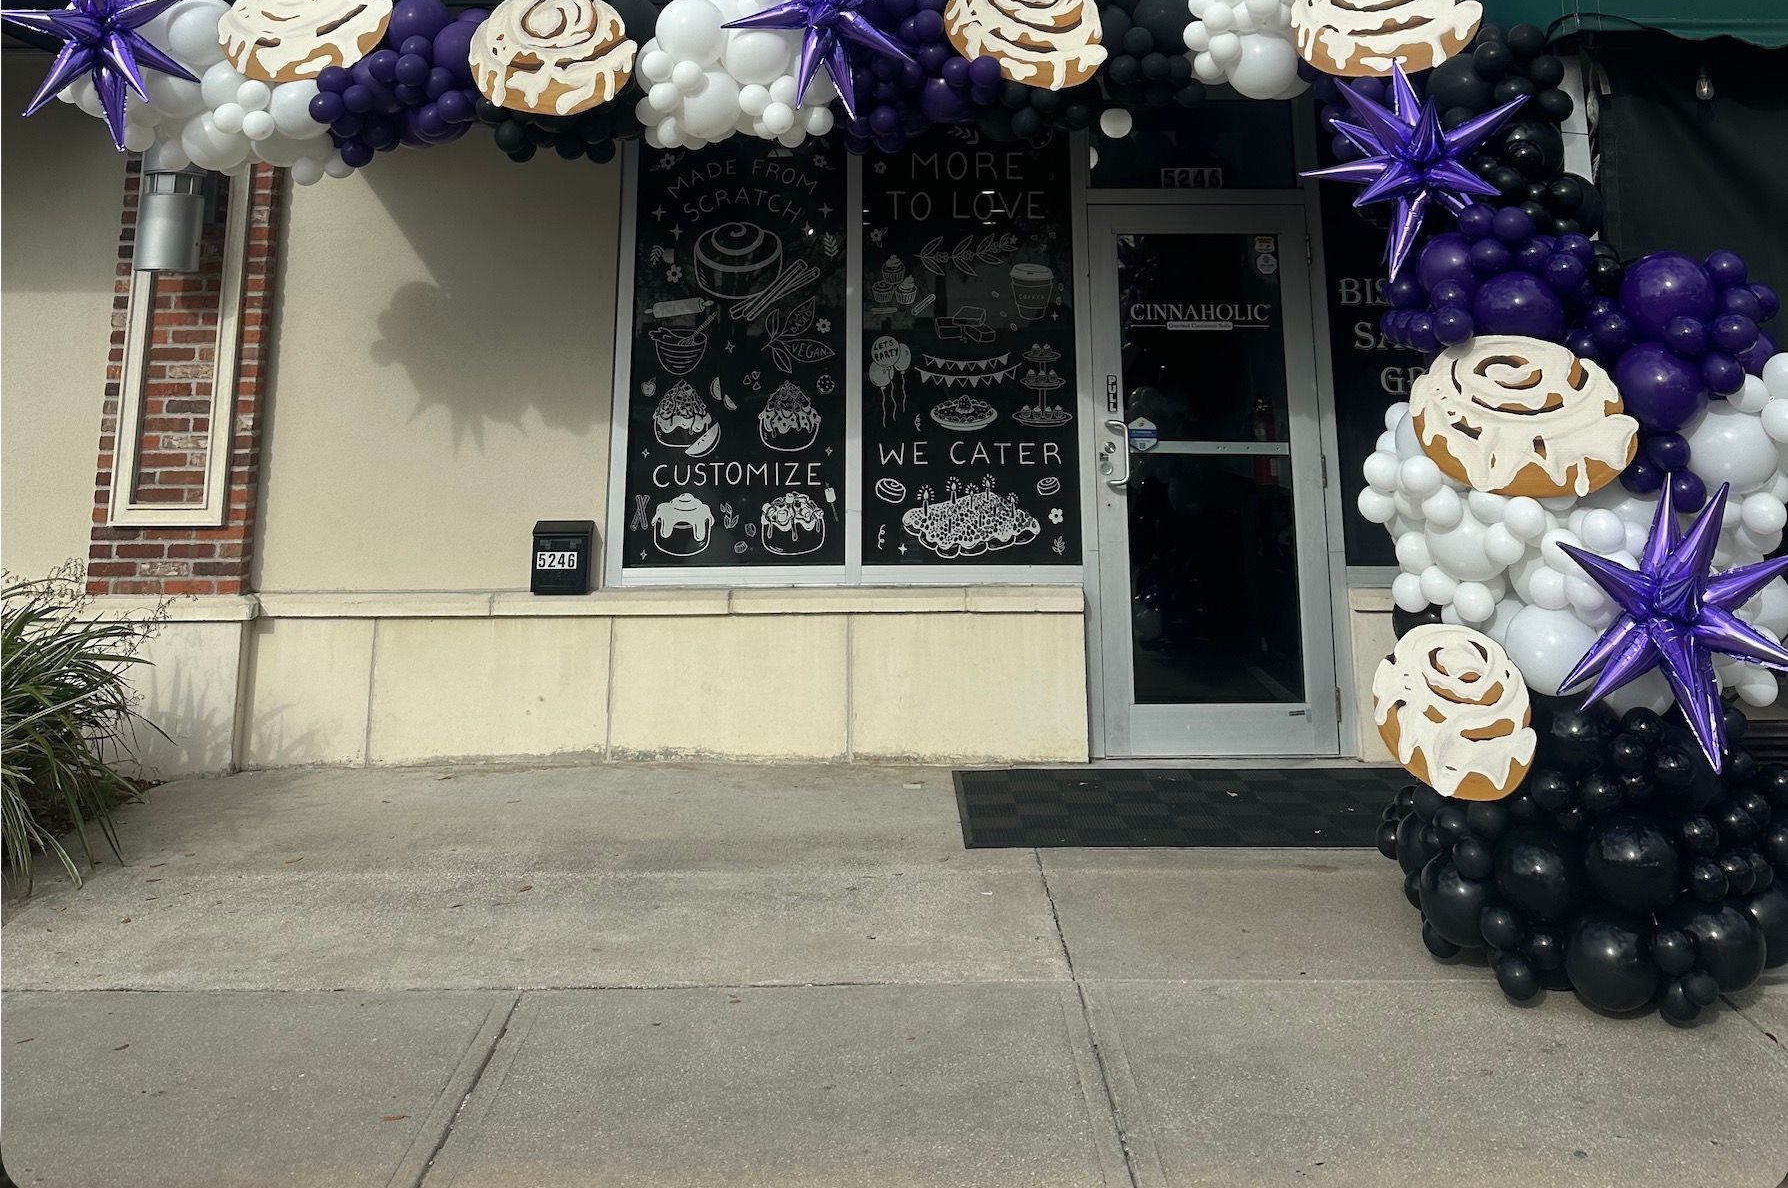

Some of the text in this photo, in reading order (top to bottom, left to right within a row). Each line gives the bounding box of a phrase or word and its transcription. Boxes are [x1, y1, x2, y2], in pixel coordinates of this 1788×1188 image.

[666, 158, 818, 200] MADE FROM
[911, 151, 1025, 181] MORE
[1163, 169, 1221, 189] 5246
[683, 186, 803, 224] SCRATCH
[885, 190, 1046, 221] TO LOVE
[1129, 303, 1270, 322] CINNAHOLIC
[791, 342, 827, 359] VEGAN
[873, 339, 894, 351] LET'S
[874, 347, 899, 362] PARTY
[1106, 375, 1118, 412] PULL
[878, 440, 1063, 466] WE CATER
[652, 461, 823, 488] CUSTOMIZE
[538, 553, 576, 568] 5246
